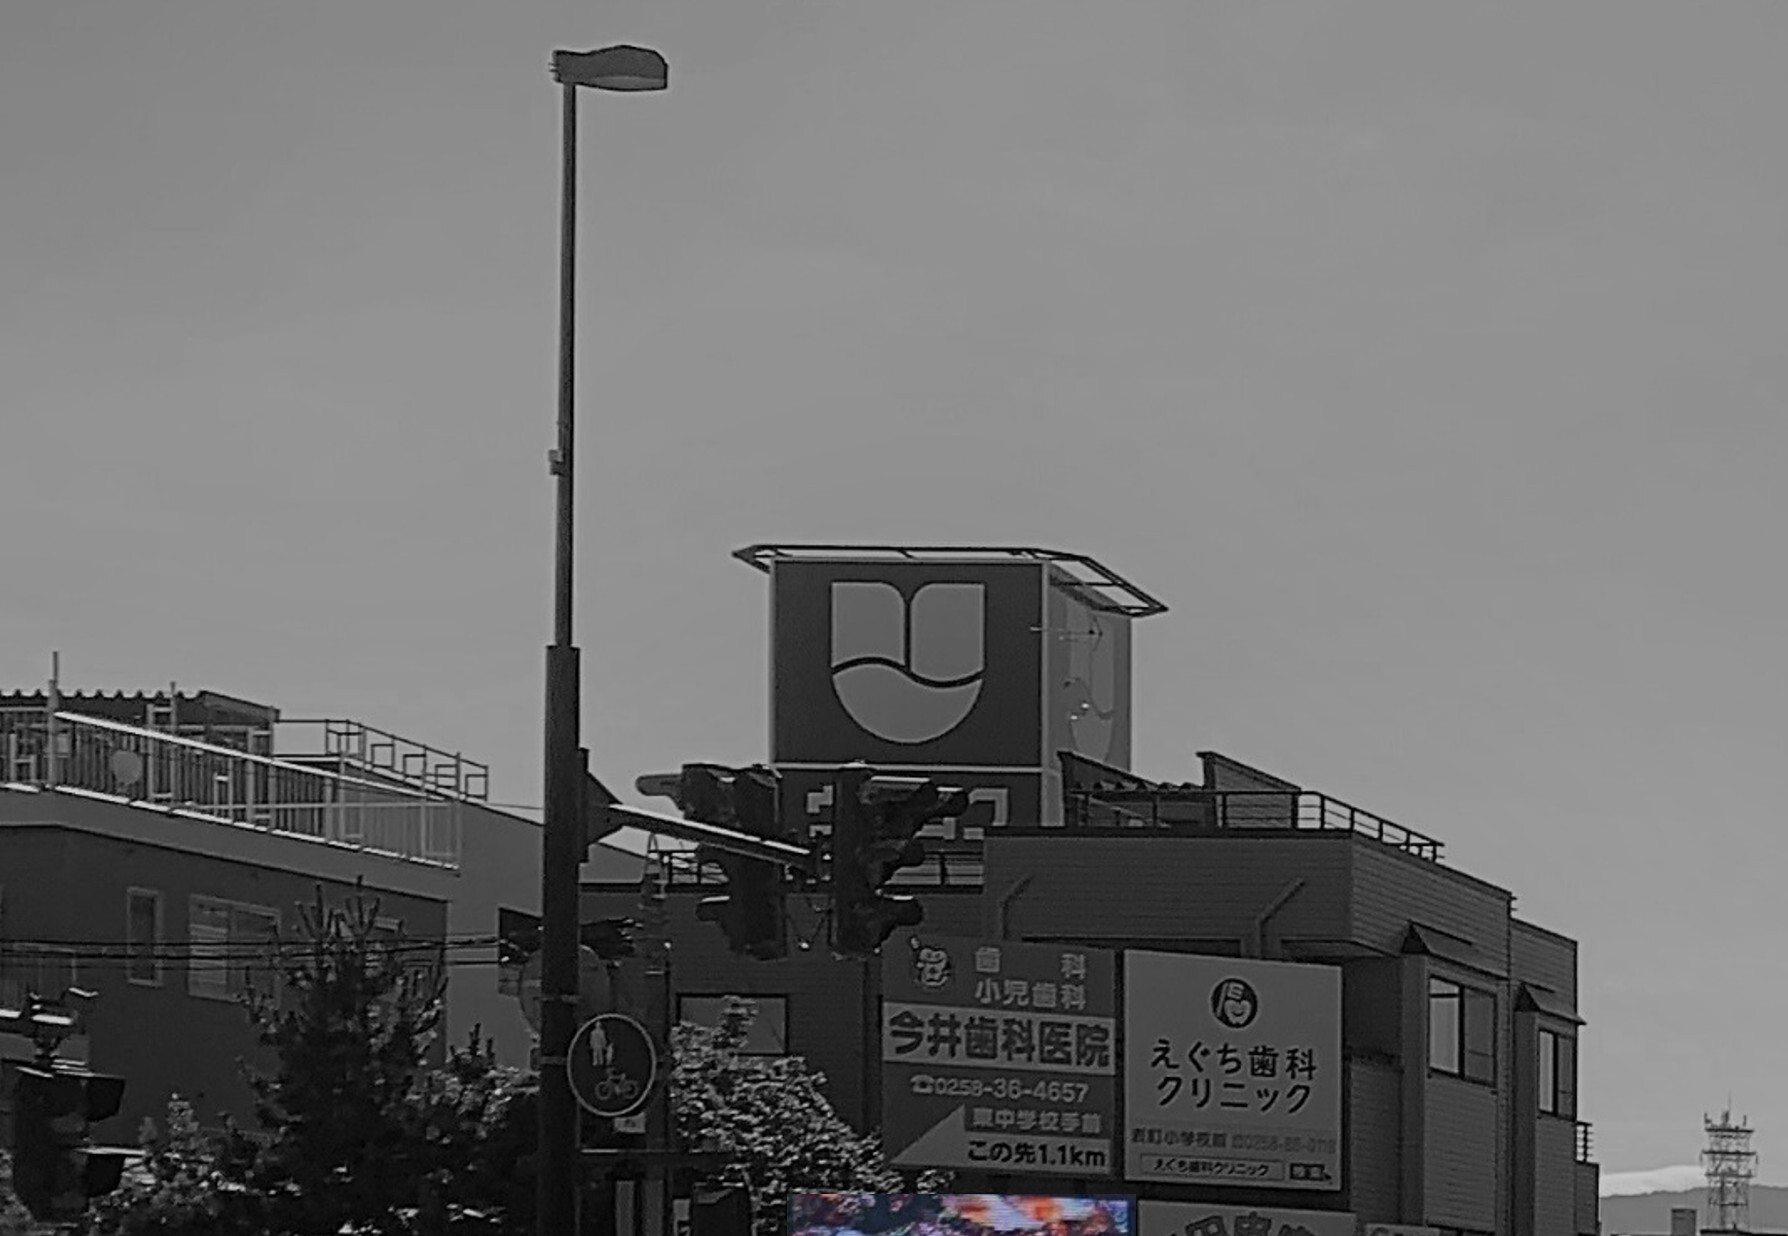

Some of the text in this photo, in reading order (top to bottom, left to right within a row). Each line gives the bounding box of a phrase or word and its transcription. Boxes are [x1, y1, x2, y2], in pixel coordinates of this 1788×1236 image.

[975, 977, 1086, 1010] 小児歯科
[890, 1011, 1110, 1067] 今井歯科医院
[1151, 1038, 1316, 1081] えぐち歯科
[934, 1077, 1089, 1103] 0258-36-4657
[1157, 1076, 1310, 1114] クリニック
[968, 1139, 1105, 1166] この先1.1km
